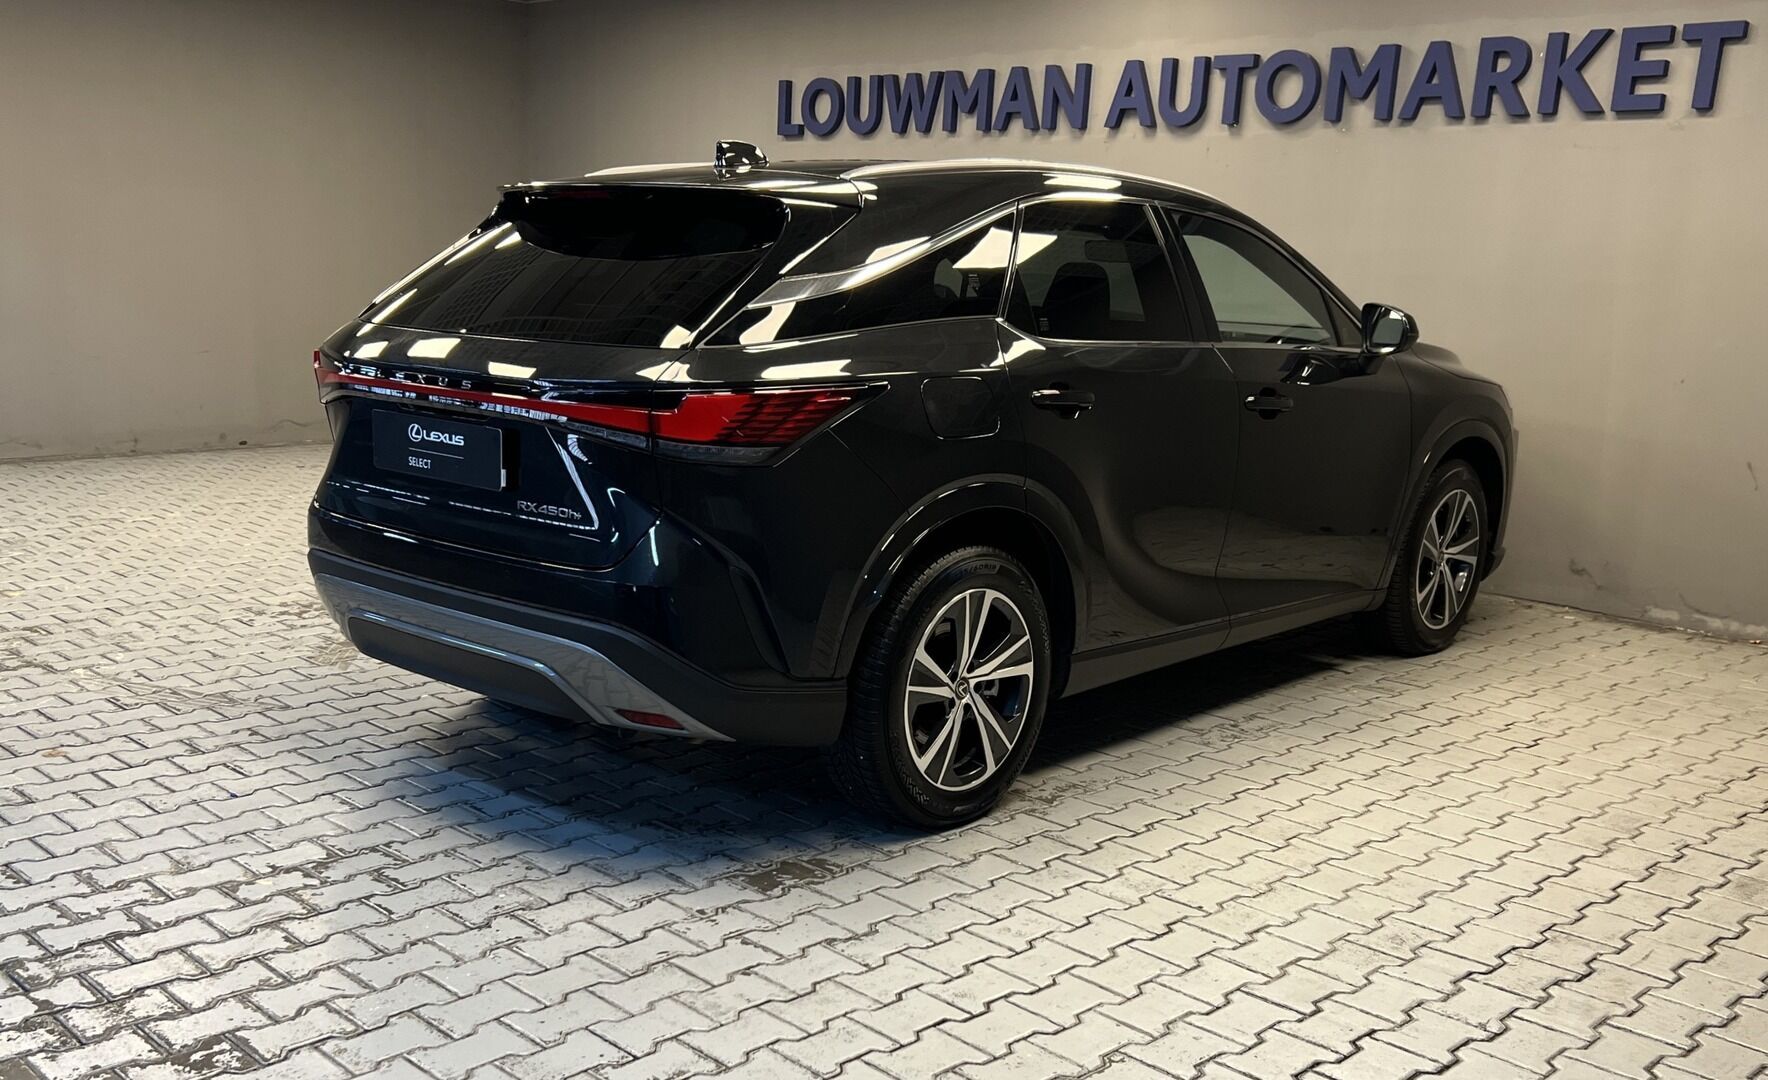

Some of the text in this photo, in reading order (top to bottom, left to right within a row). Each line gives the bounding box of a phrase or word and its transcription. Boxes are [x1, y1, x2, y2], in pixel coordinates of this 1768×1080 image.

[777, 20, 1750, 137] LOUWMAN AUTOMARKET
[423, 430, 465, 446] LEXUS
[408, 456, 432, 470] SELECT
